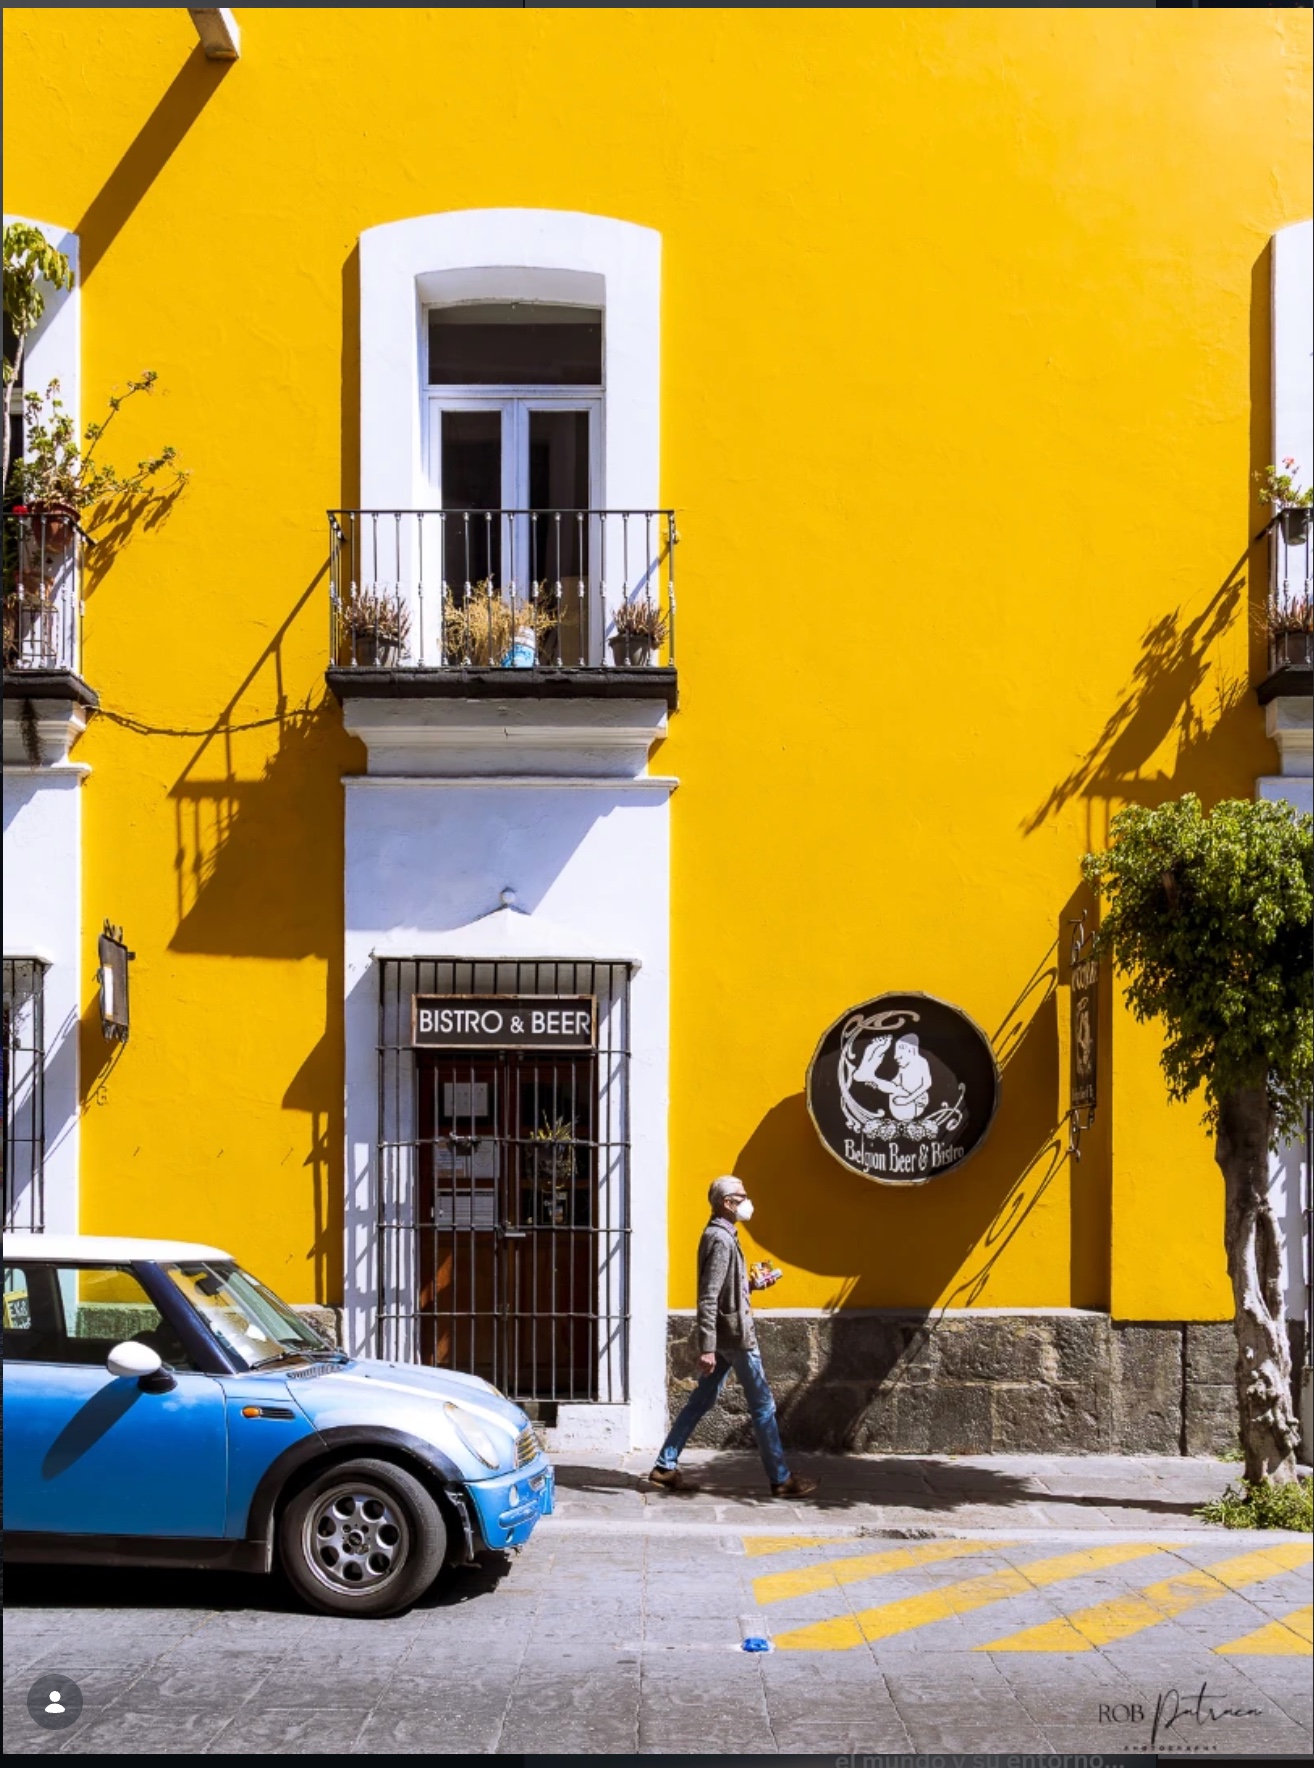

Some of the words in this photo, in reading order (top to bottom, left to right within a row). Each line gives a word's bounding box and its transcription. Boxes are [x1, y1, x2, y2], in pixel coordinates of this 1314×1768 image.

[419, 1009, 503, 1033] BISTRO
[510, 1016, 524, 1033] &
[531, 1011, 590, 1035] BEER
[844, 1136, 886, 1172] Belgian
[888, 1142, 916, 1172] Beer
[918, 1143, 928, 1171] &
[930, 1141, 964, 1168] Bistro
